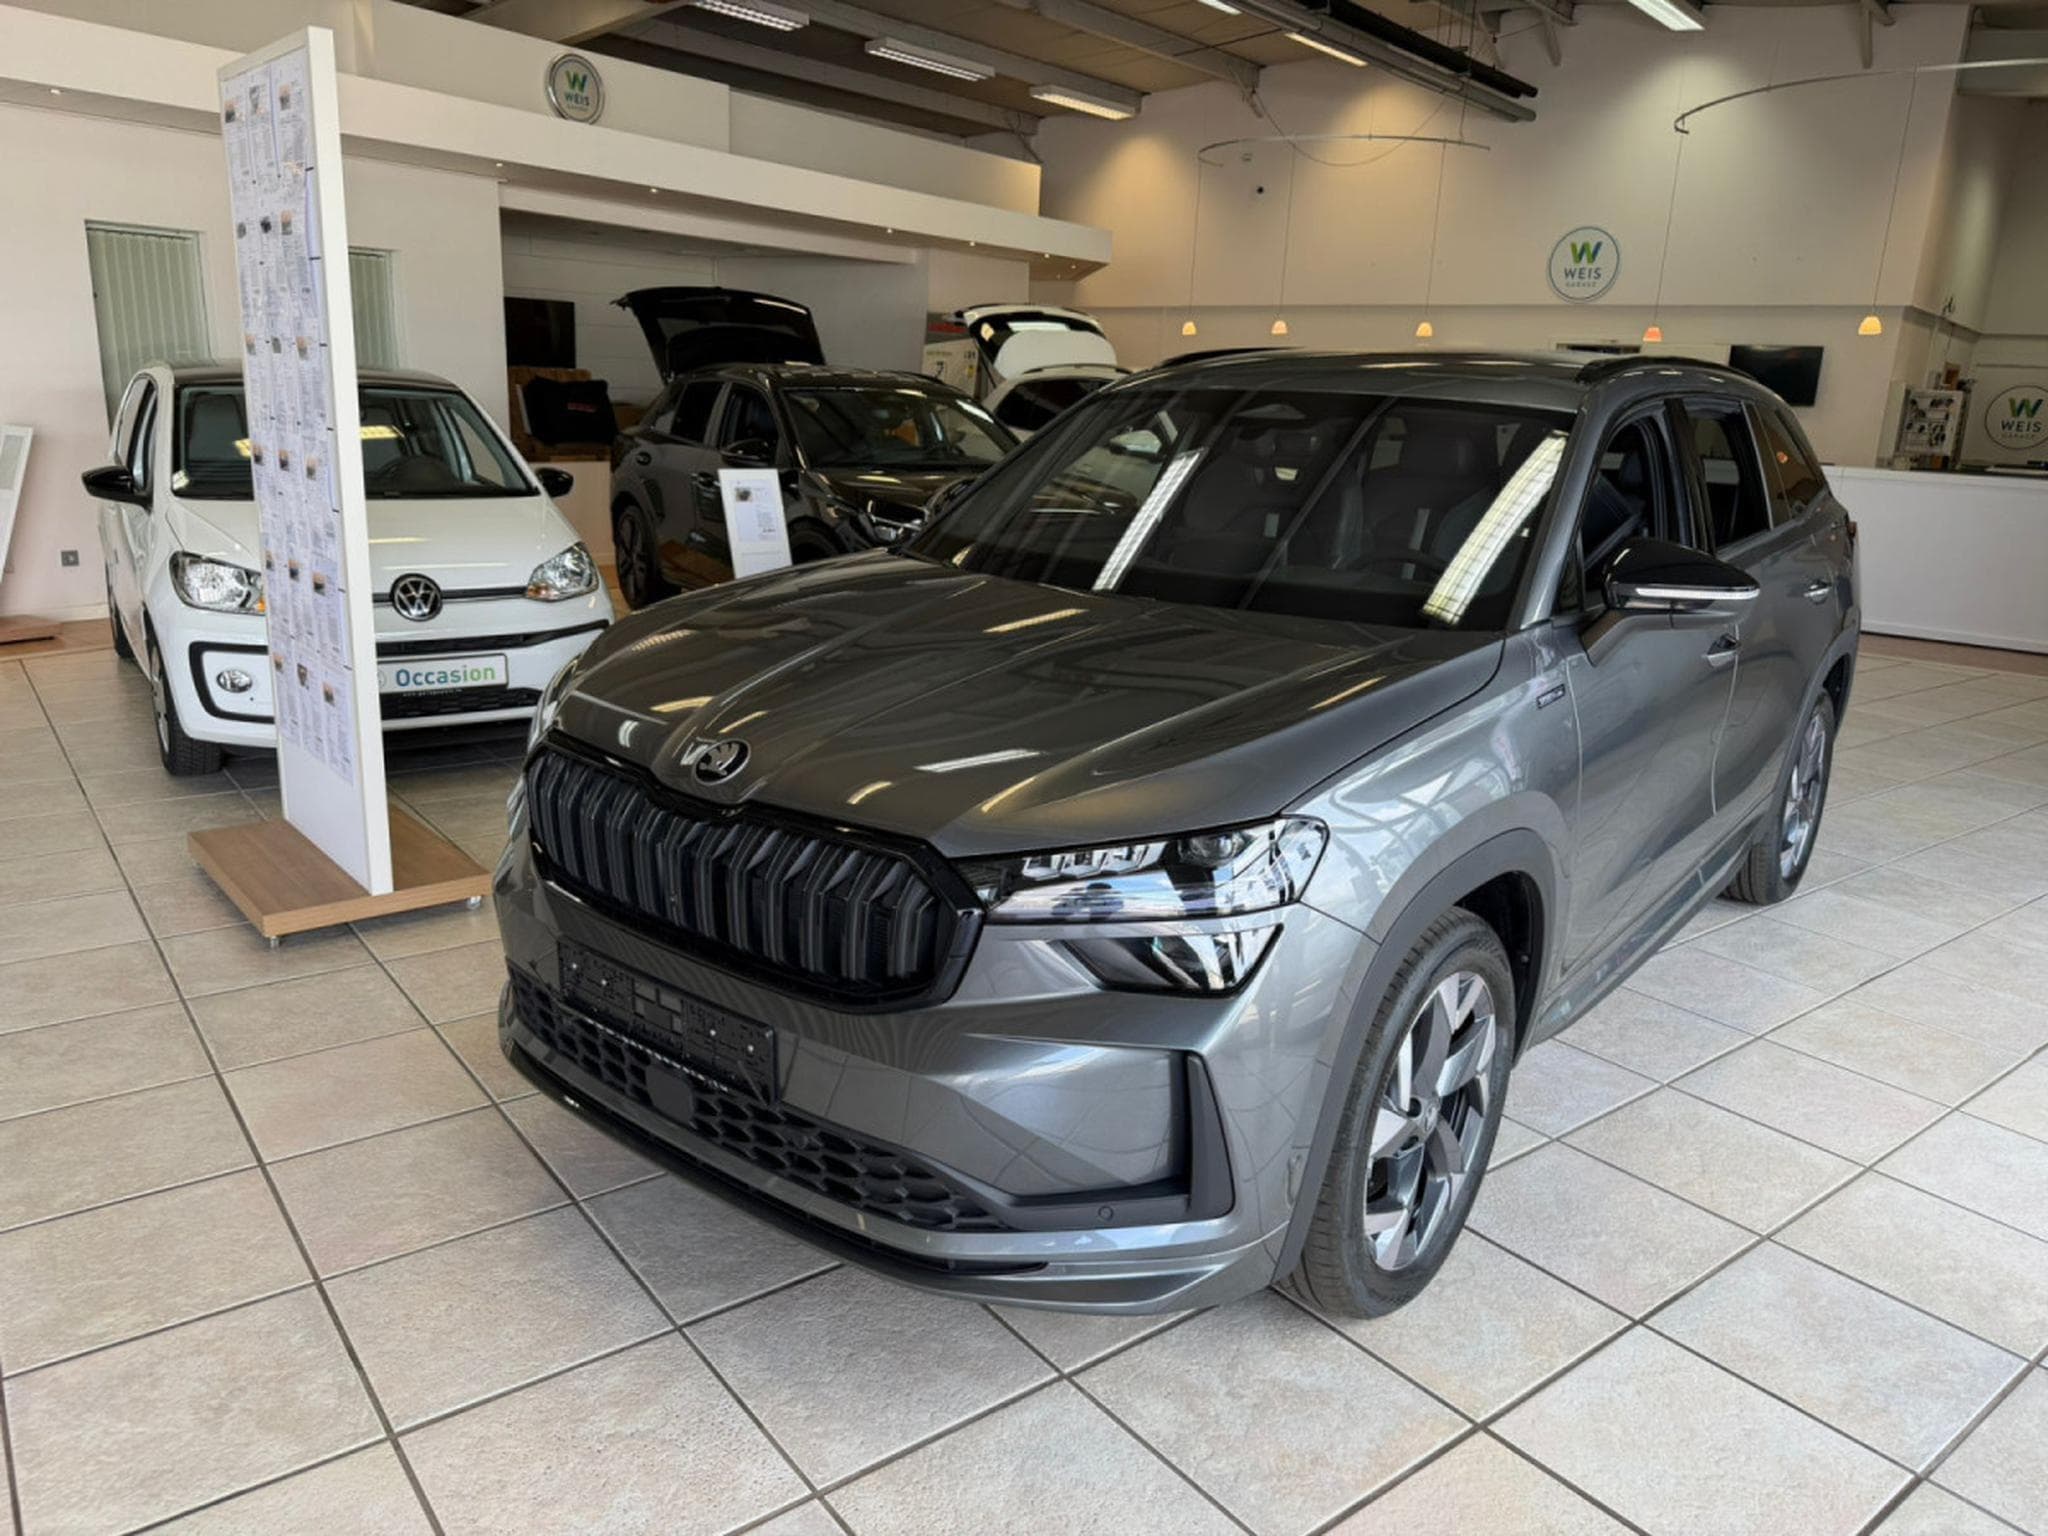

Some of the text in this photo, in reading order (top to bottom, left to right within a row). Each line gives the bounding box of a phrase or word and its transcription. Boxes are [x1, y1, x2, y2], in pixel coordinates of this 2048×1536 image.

[564, 92, 590, 106] WEIS
[1570, 241, 1602, 264] W
[1564, 267, 1602, 279] WEIS
[2008, 398, 2043, 417] W
[2001, 420, 2042, 432] WEIS
[395, 664, 496, 688] Occasion
